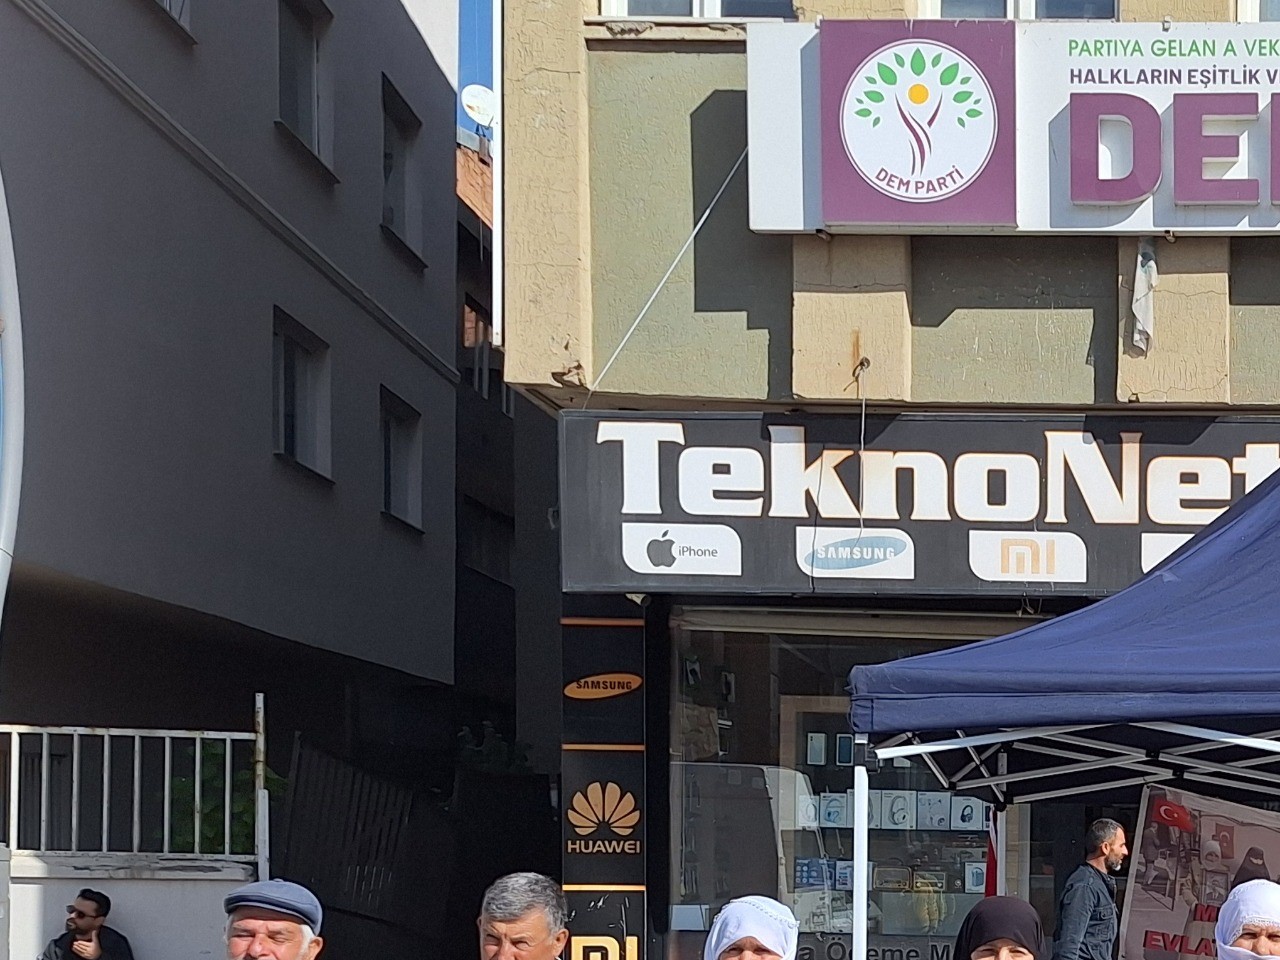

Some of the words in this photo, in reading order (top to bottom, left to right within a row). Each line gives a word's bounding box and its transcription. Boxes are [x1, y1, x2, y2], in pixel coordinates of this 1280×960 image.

[1068, 39, 1143, 57] PARTIYA
[1150, 38, 1216, 57] GELAN
[1223, 39, 1238, 56] A
[1070, 68, 1182, 87] HALKLARIN
[1187, 65, 1261, 89] EŞİTLİK
[875, 166, 912, 194] DEM
[914, 164, 964, 195] PARTİ
[678, 545, 718, 560] iPhone
[816, 545, 896, 560] SAMSUNG
[576, 679, 633, 691] SAMSUNG
[567, 839, 641, 854] HUAWEI
